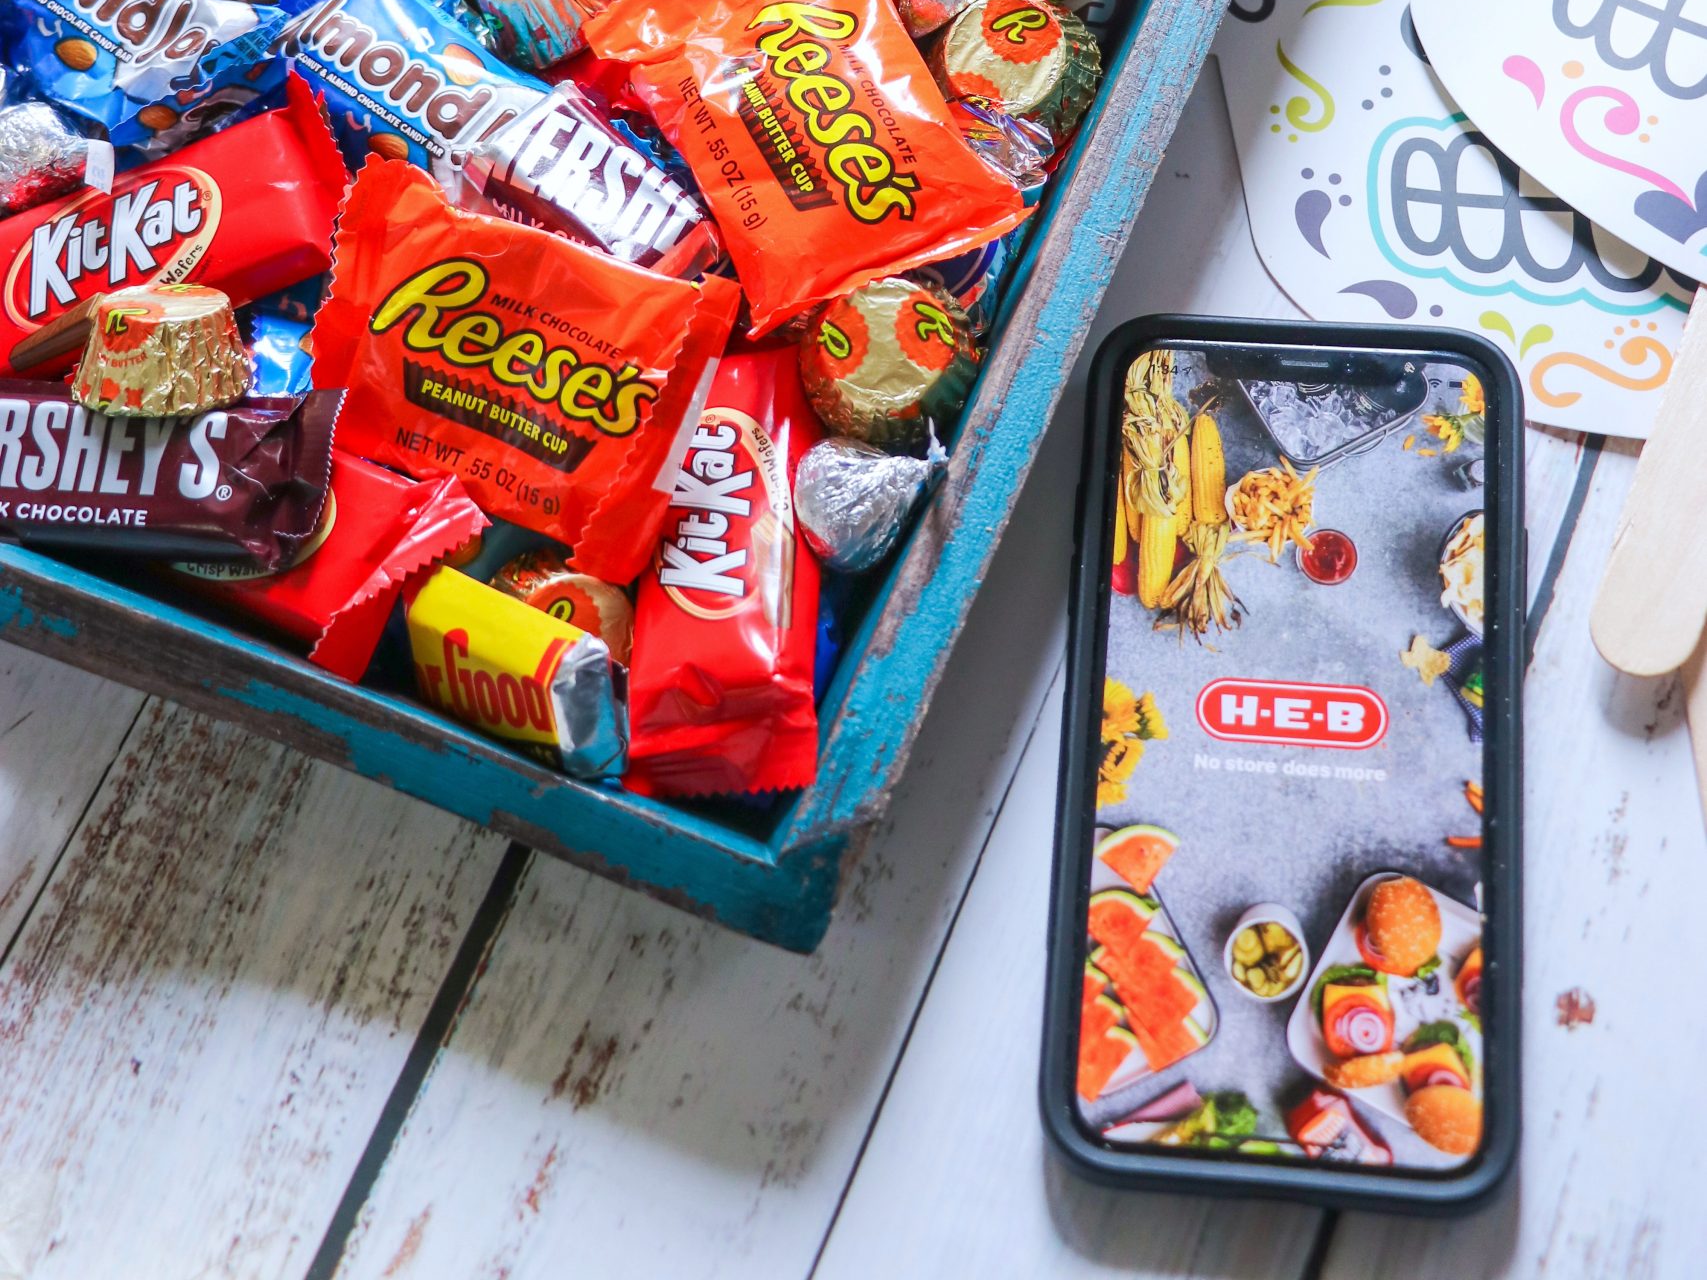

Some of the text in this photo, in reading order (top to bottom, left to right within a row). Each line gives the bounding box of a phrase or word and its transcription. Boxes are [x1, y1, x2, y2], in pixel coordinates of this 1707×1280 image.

[46, 0, 92, 36] CHOCOLATE
[89, 30, 118, 55] CANDY
[114, 46, 134, 64] BAR
[988, 6, 1050, 45] R
[326, 73, 358, 98] ALMOND
[356, 93, 402, 129] CHOCOLATE
[399, 122, 429, 147] CANDY
[425, 140, 445, 159] BAR
[678, 75, 769, 232] NET WT .55 OZ (15 g)
[744, 1, 922, 224] Reese's
[757, 107, 797, 165] BUTTER
[790, 162, 816, 193] CUP
[860, 78, 917, 165] CHOCOLATE
[159, 241, 205, 286] Wafers
[368, 255, 662, 438] Reese's
[489, 292, 625, 360] MILK CHOCOLATE
[420, 377, 569, 456] PEANUT BUTTER CUP
[395, 425, 562, 516] NET WT .55 OZ (15 g)
[15, 502, 149, 529] CHOCOLATE
[1193, 753, 1388, 782] No store does more
